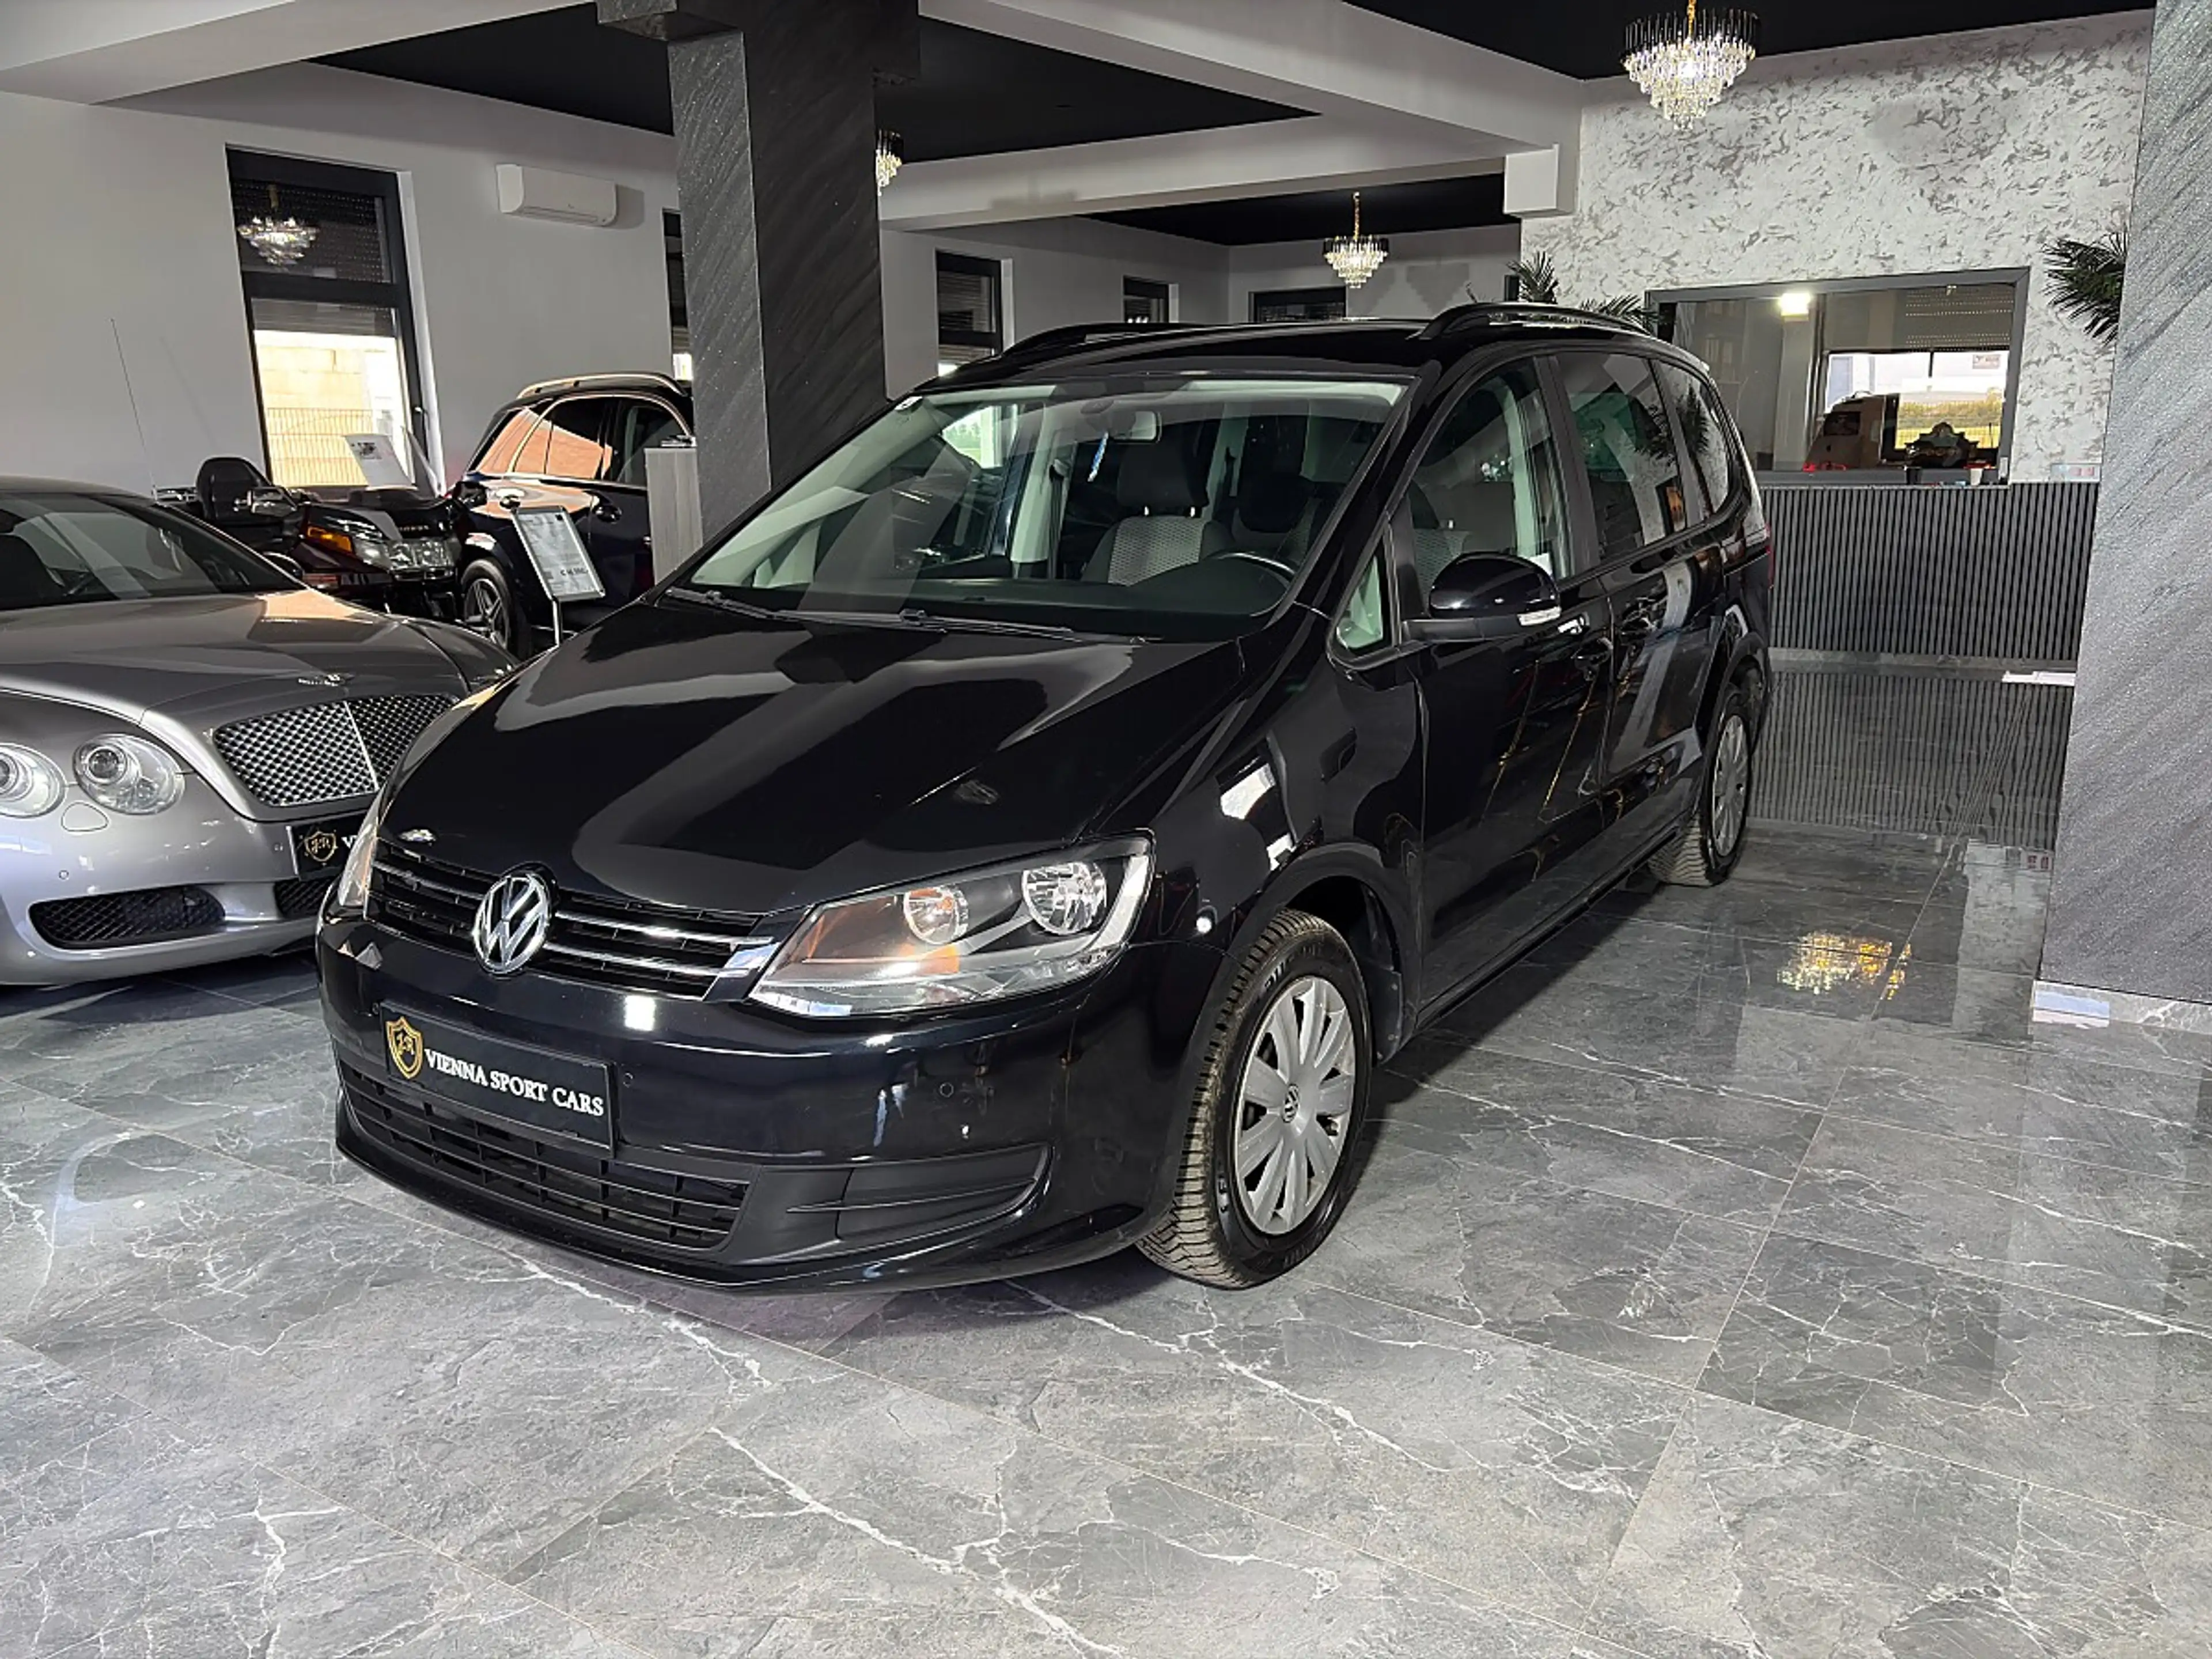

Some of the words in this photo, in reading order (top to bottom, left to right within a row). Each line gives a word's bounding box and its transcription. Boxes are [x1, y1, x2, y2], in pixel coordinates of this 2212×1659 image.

[425, 1048, 488, 1086] VIENNA
[490, 1071, 548, 1103] SPORT
[552, 1087, 604, 1116] CARS
